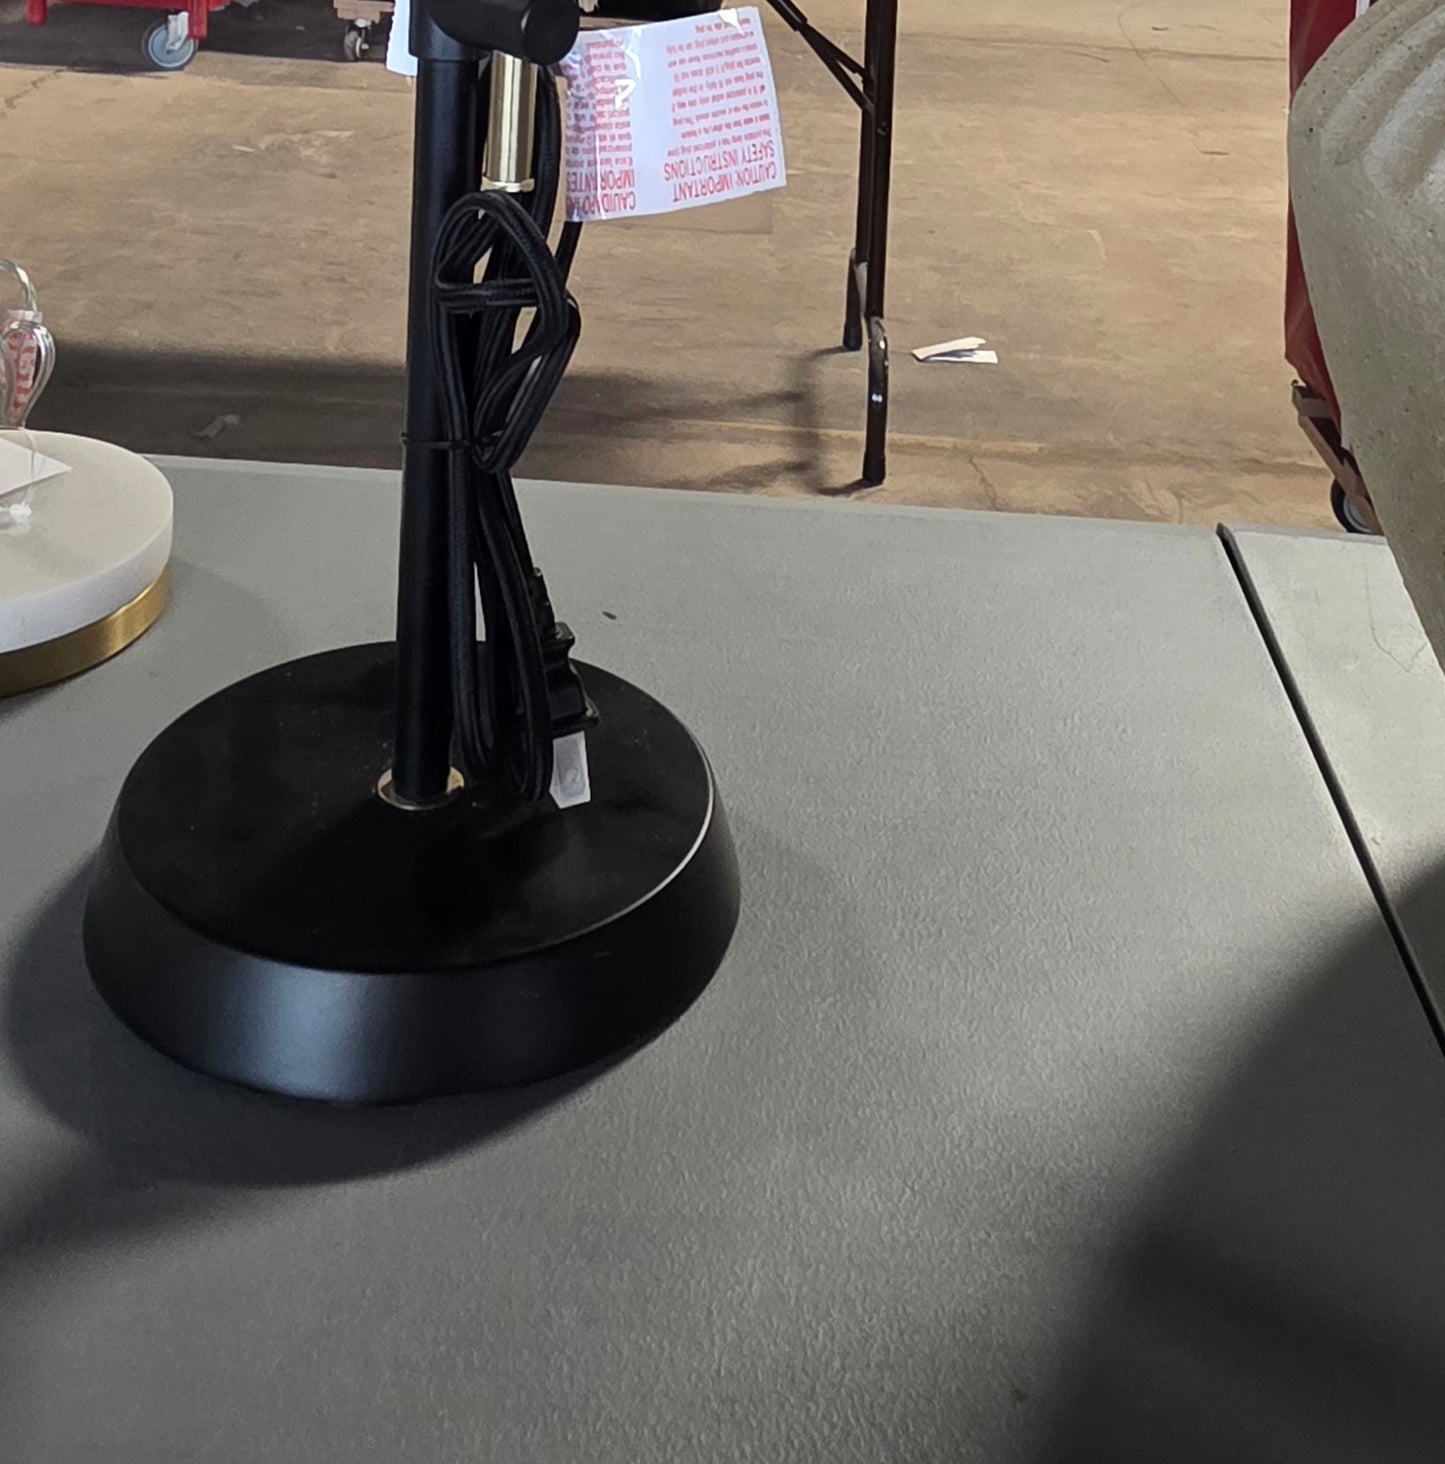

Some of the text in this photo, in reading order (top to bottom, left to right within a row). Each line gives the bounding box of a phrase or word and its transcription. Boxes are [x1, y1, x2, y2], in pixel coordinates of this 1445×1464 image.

[663, 139, 775, 182] SAFETY INSTRUCTIONS
[672, 161, 778, 203] CAUTION: IMPORTANT
